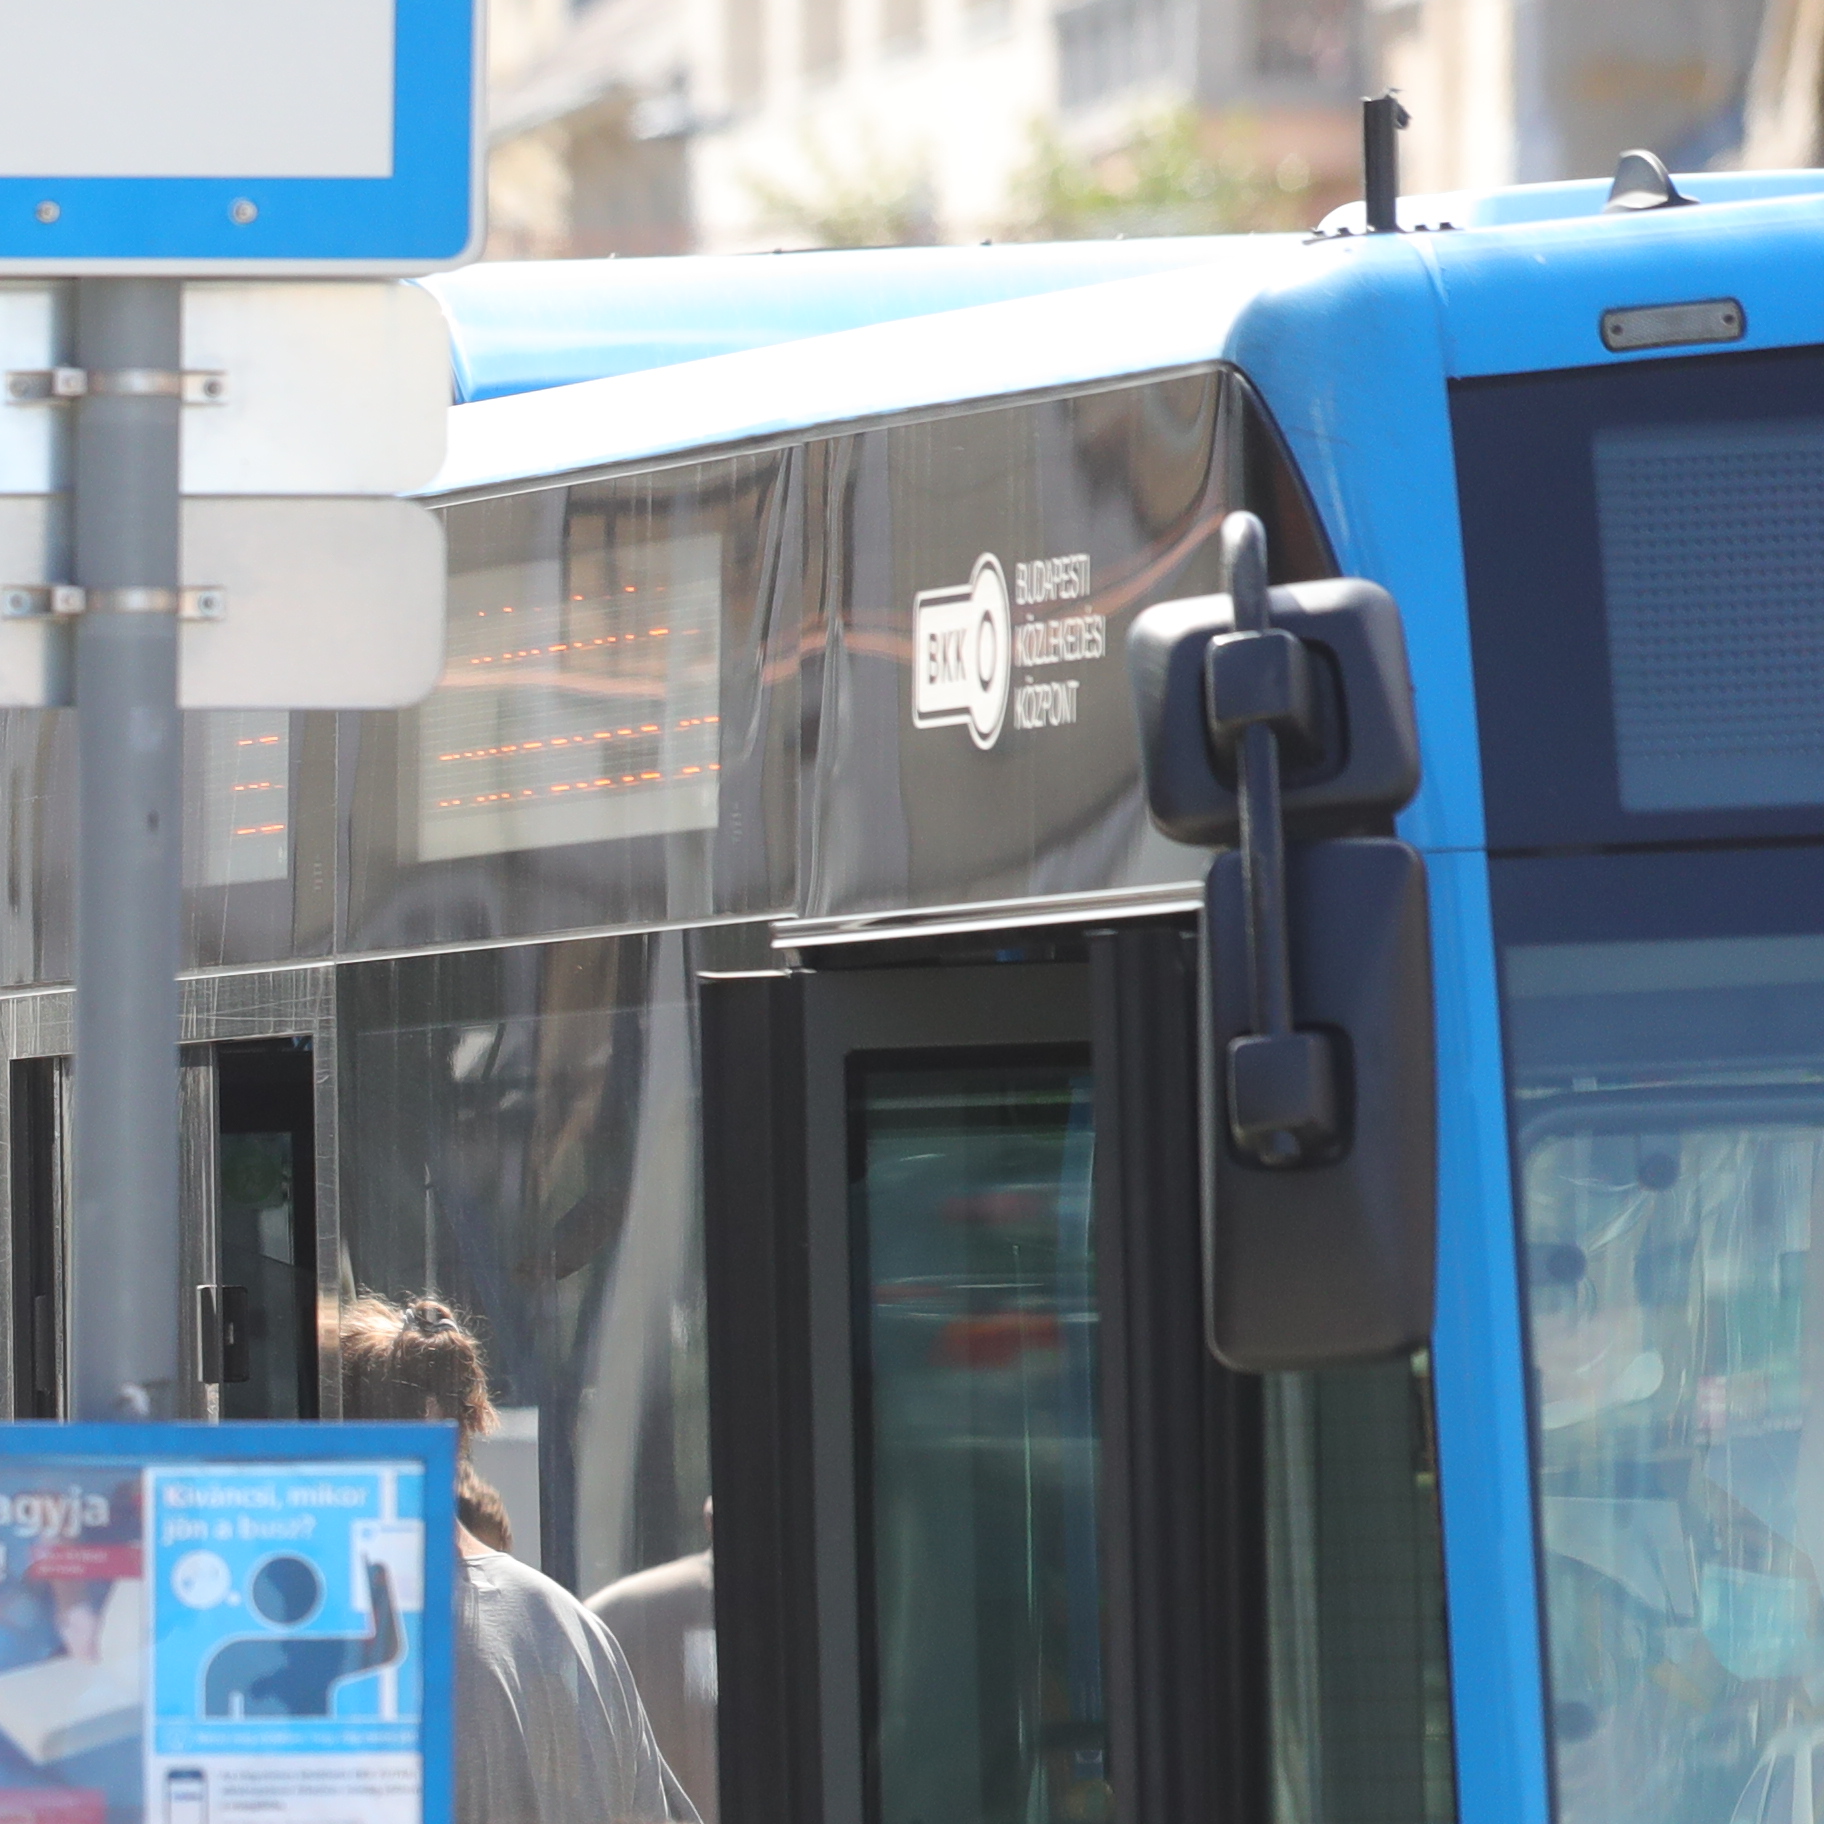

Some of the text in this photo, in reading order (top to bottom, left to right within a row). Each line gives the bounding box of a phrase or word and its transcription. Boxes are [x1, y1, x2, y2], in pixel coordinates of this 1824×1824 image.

[1015, 553, 1091, 606] BUDAPESTI
[928, 626, 968, 686] BKK
[1014, 606, 1107, 669] KÖZLEKEDÉSI
[1013, 675, 1080, 731] KÖZPONT
[286, 1483, 369, 1508] mikor
[214, 1519, 234, 1541] a
